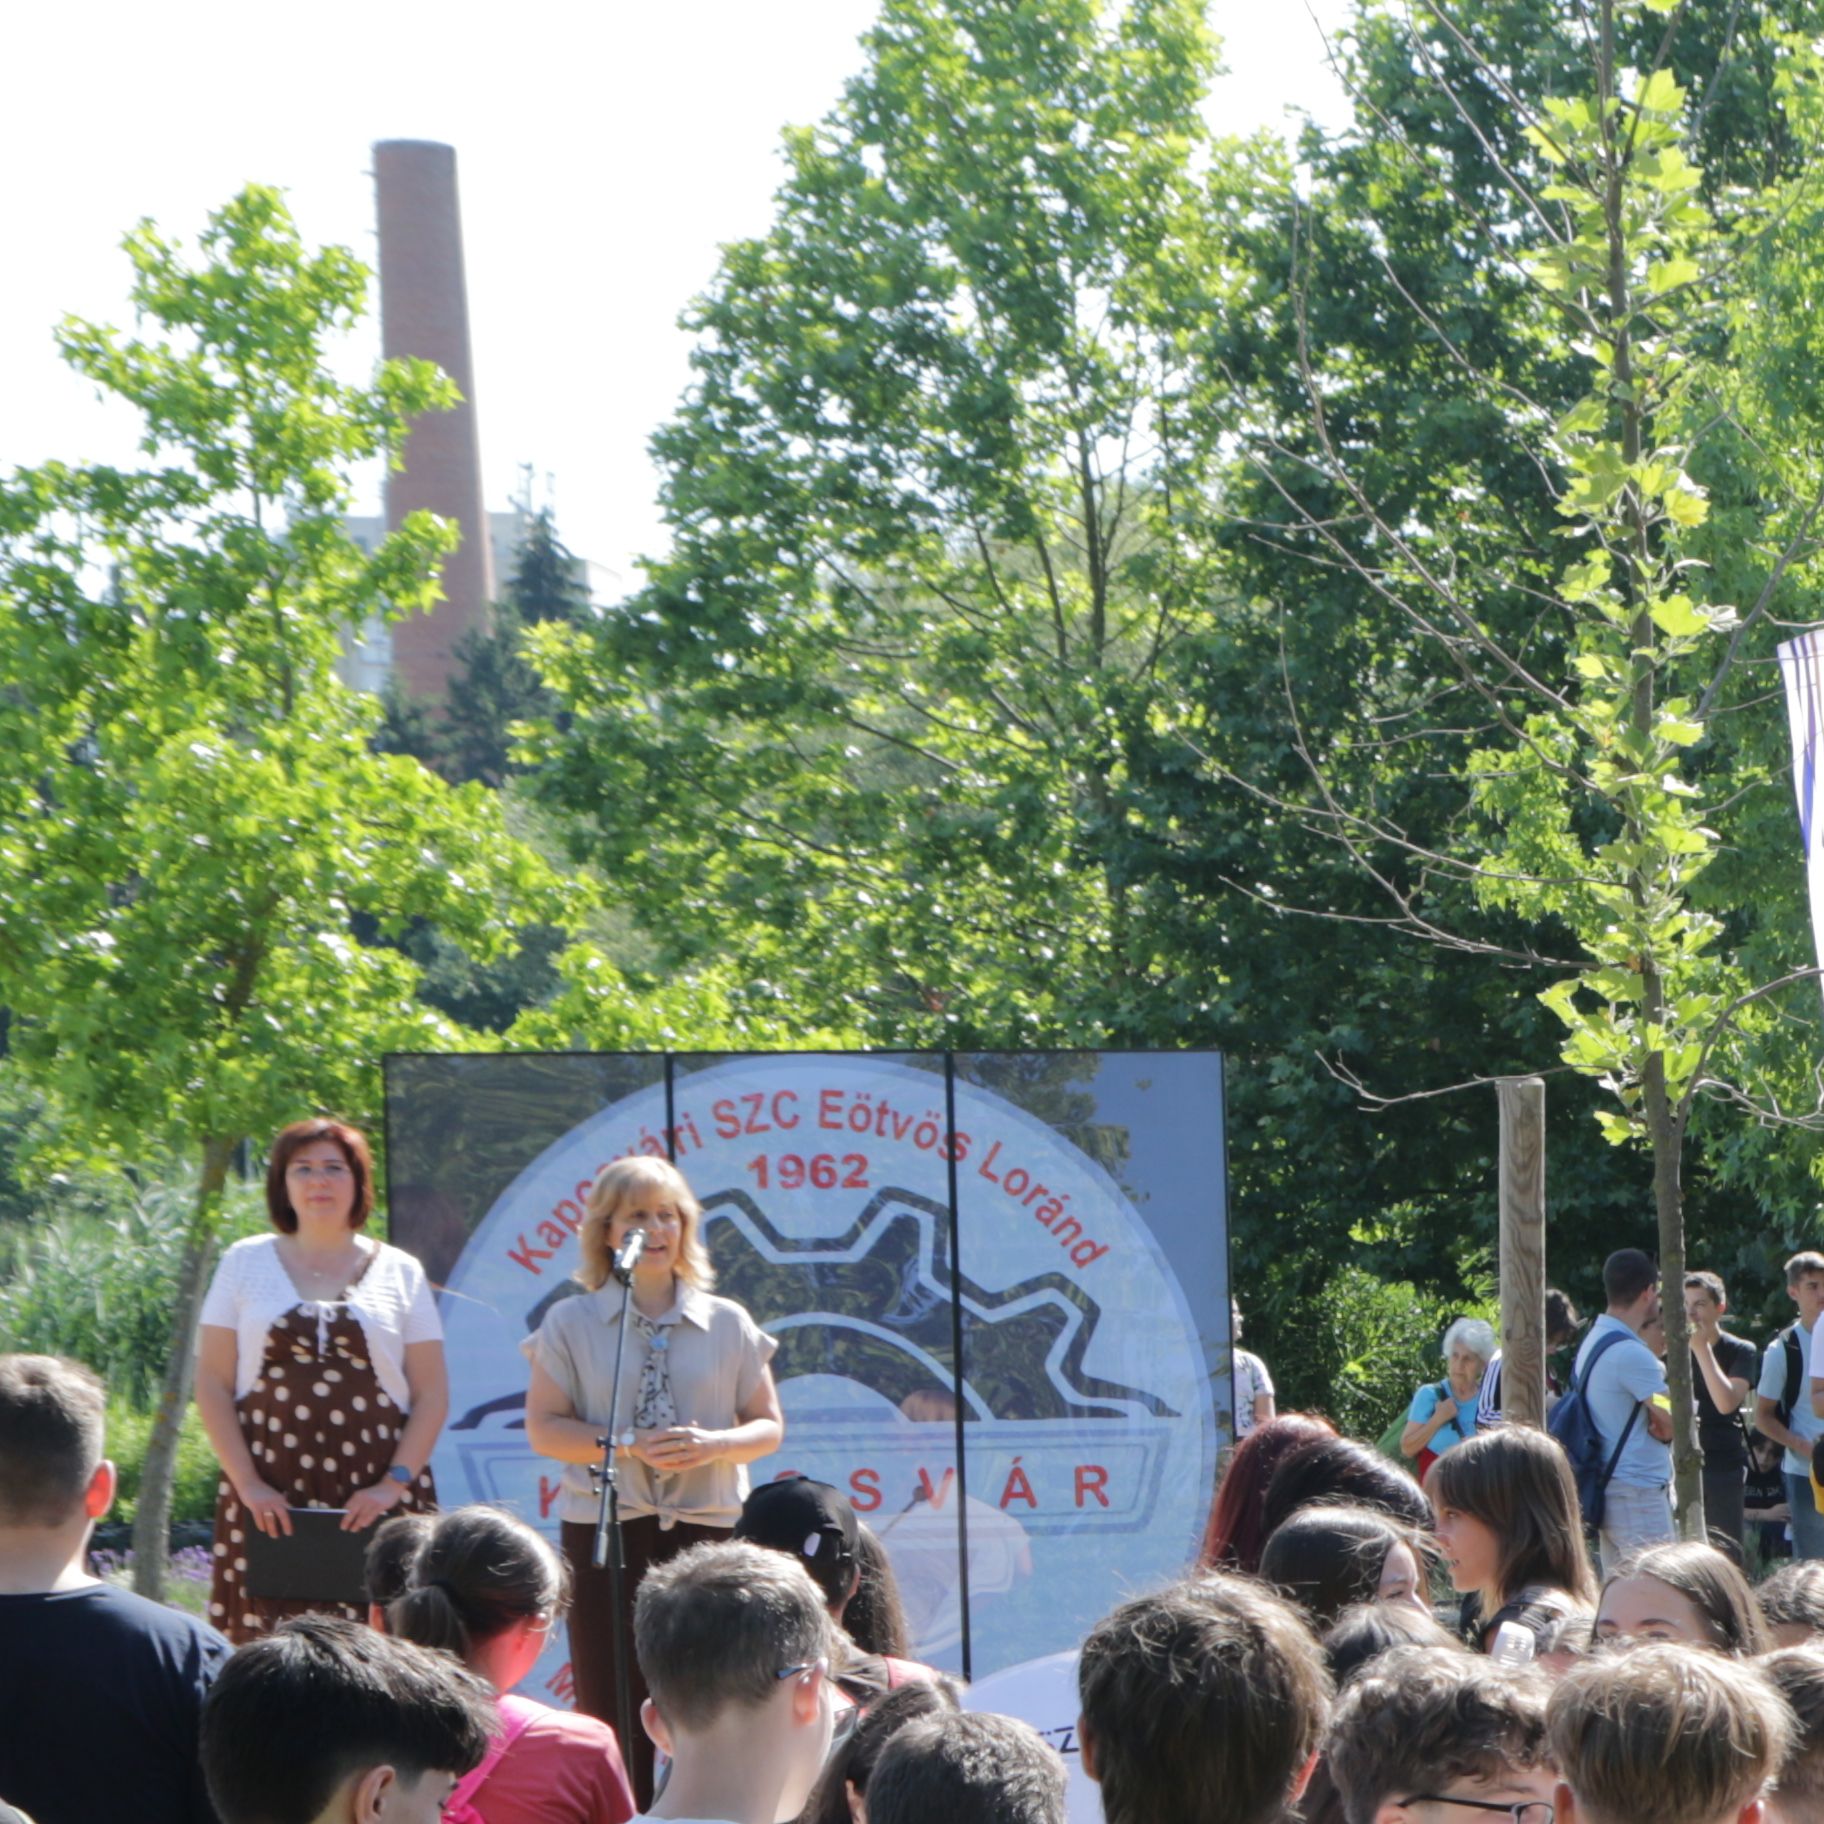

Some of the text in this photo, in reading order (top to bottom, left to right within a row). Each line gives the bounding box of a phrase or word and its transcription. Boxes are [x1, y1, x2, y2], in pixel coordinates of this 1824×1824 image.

[712, 1089, 802, 1139] SZC
[818, 1089, 972, 1162] Eötvös
[978, 1140, 1110, 1269] Loránd
[748, 1153, 869, 1189] 1962
